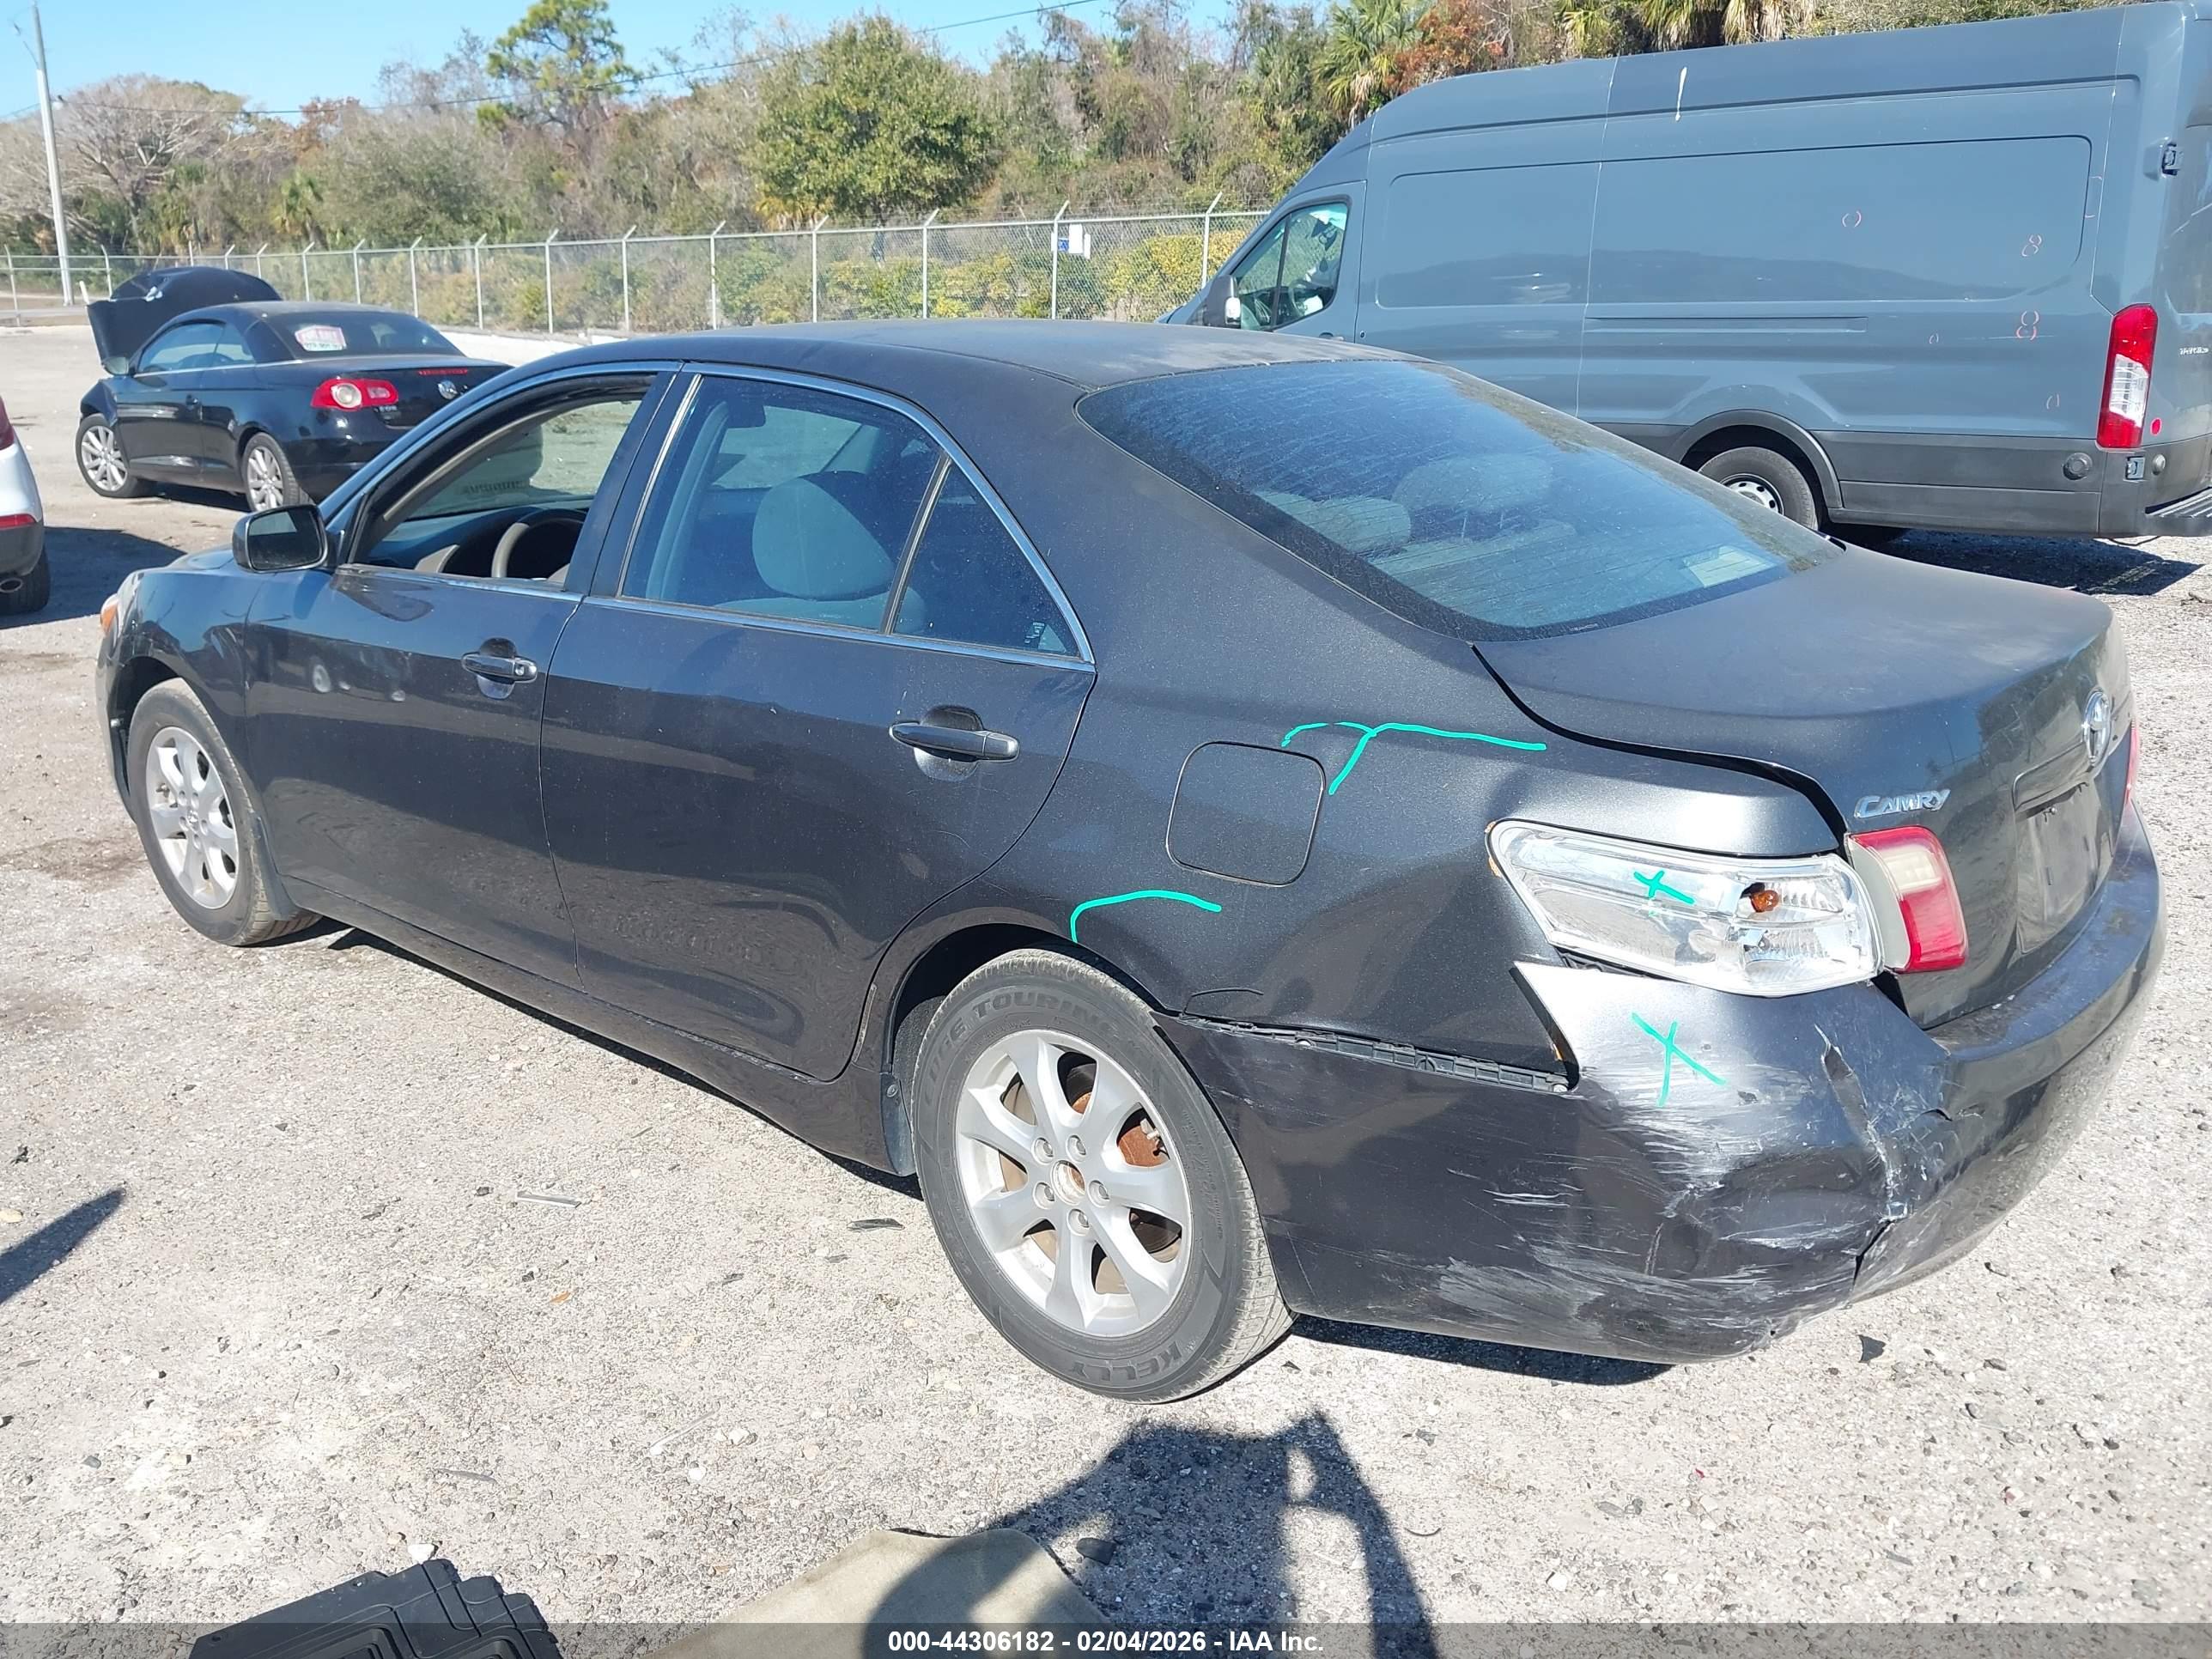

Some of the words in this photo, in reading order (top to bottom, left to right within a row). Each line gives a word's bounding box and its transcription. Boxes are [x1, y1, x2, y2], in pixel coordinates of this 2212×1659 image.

[1854, 789, 1951, 817] CAMRY
[972, 991, 1119, 1039] TOURING
[1071, 1340, 1182, 1382] KELLY
